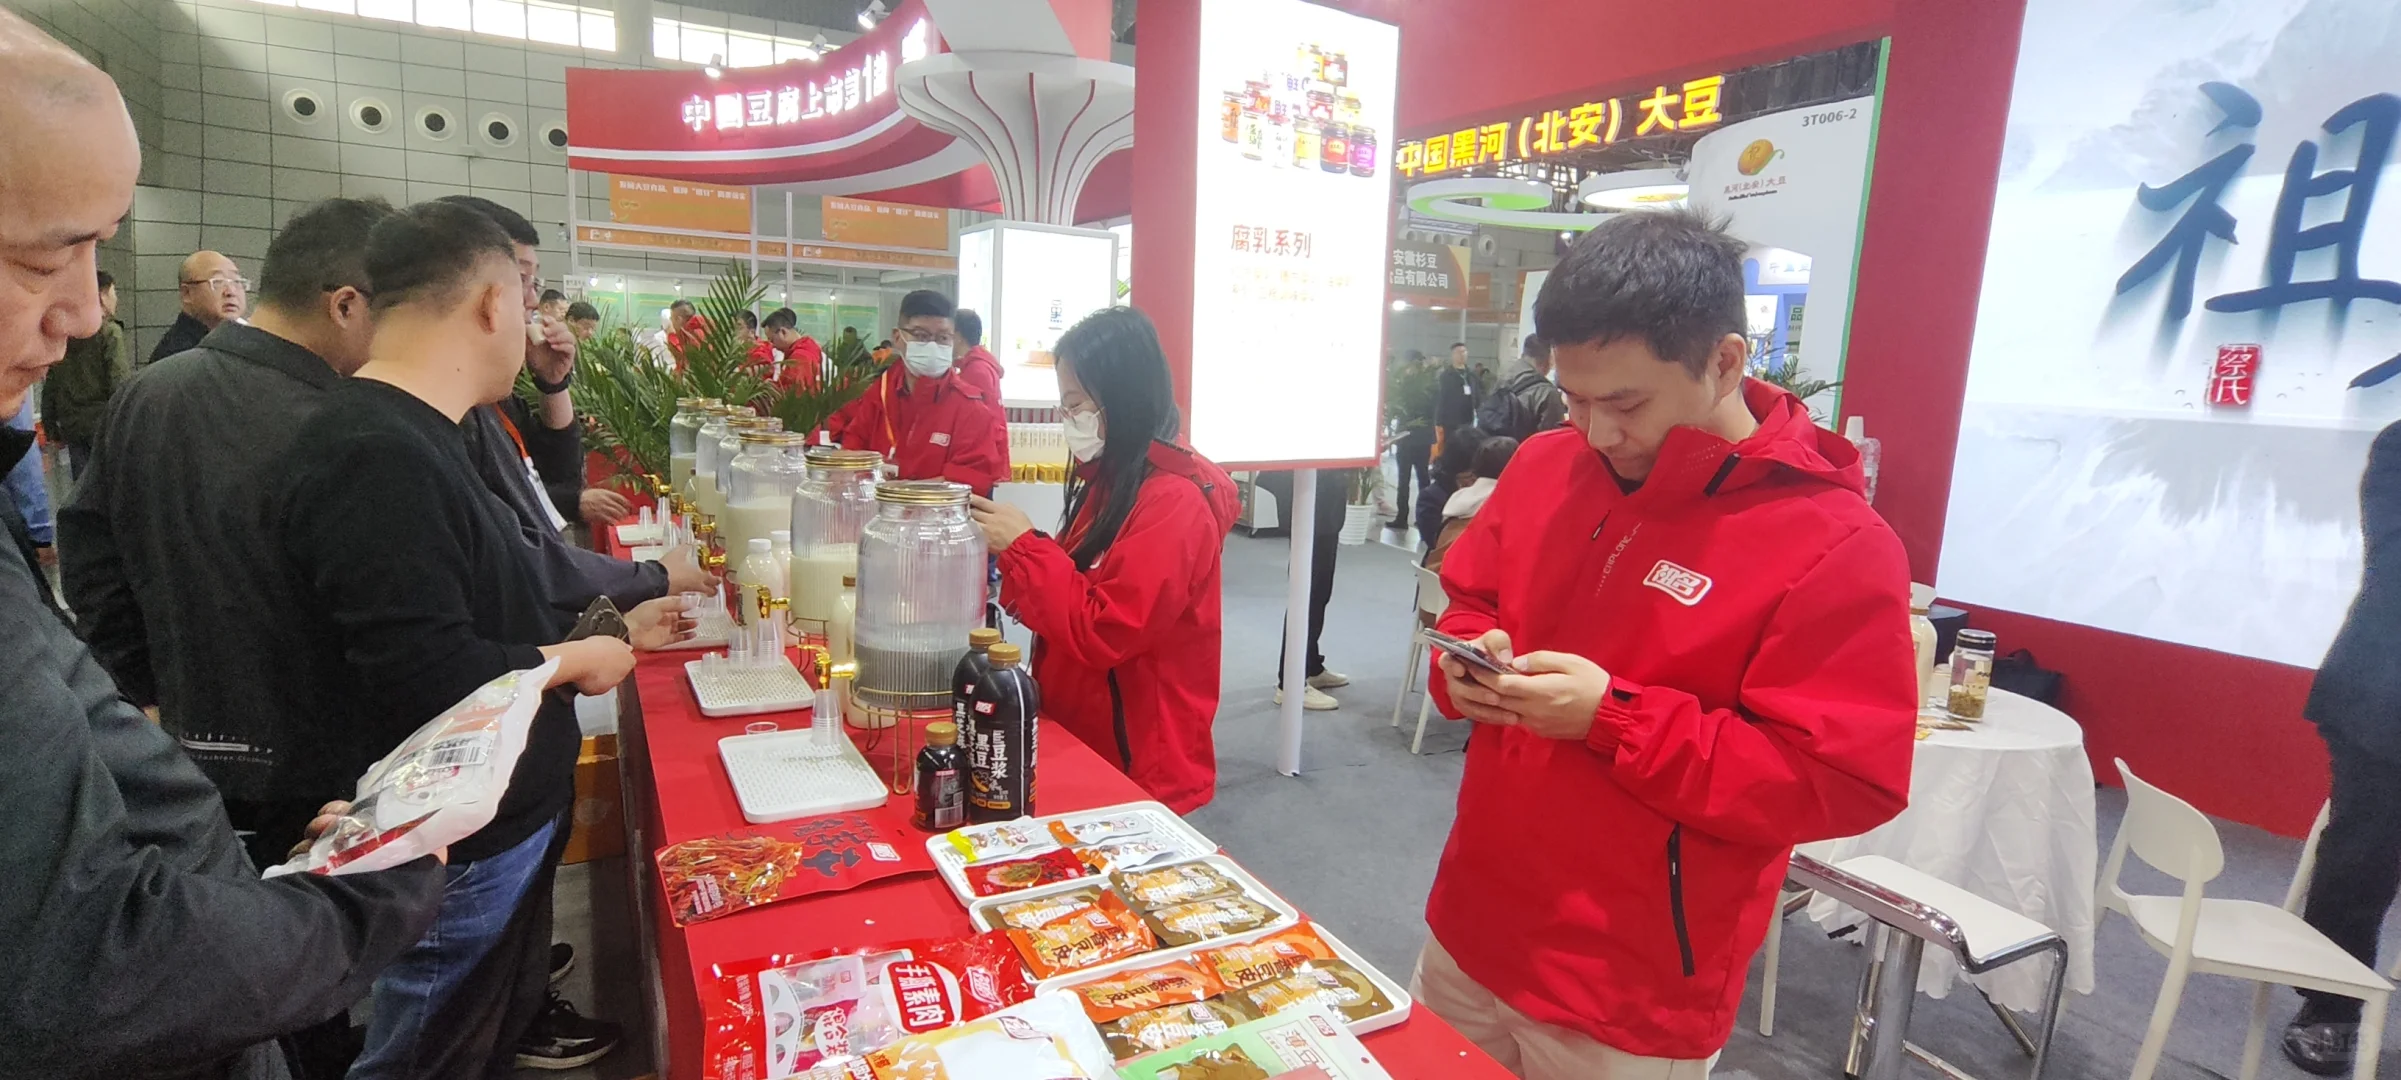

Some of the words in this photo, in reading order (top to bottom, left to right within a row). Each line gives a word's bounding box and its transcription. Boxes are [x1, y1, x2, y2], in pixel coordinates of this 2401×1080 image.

[1396, 75, 1725, 177] 中国黑河(北安)大豆
[1802, 108, 1857, 127] 3T006-2
[1230, 224, 1312, 259] 腐乳系列
[1389, 269, 1449, 289] 品有限公司
[2213, 345, 2254, 406] 蔡氏
[975, 733, 990, 769] 黑豆
